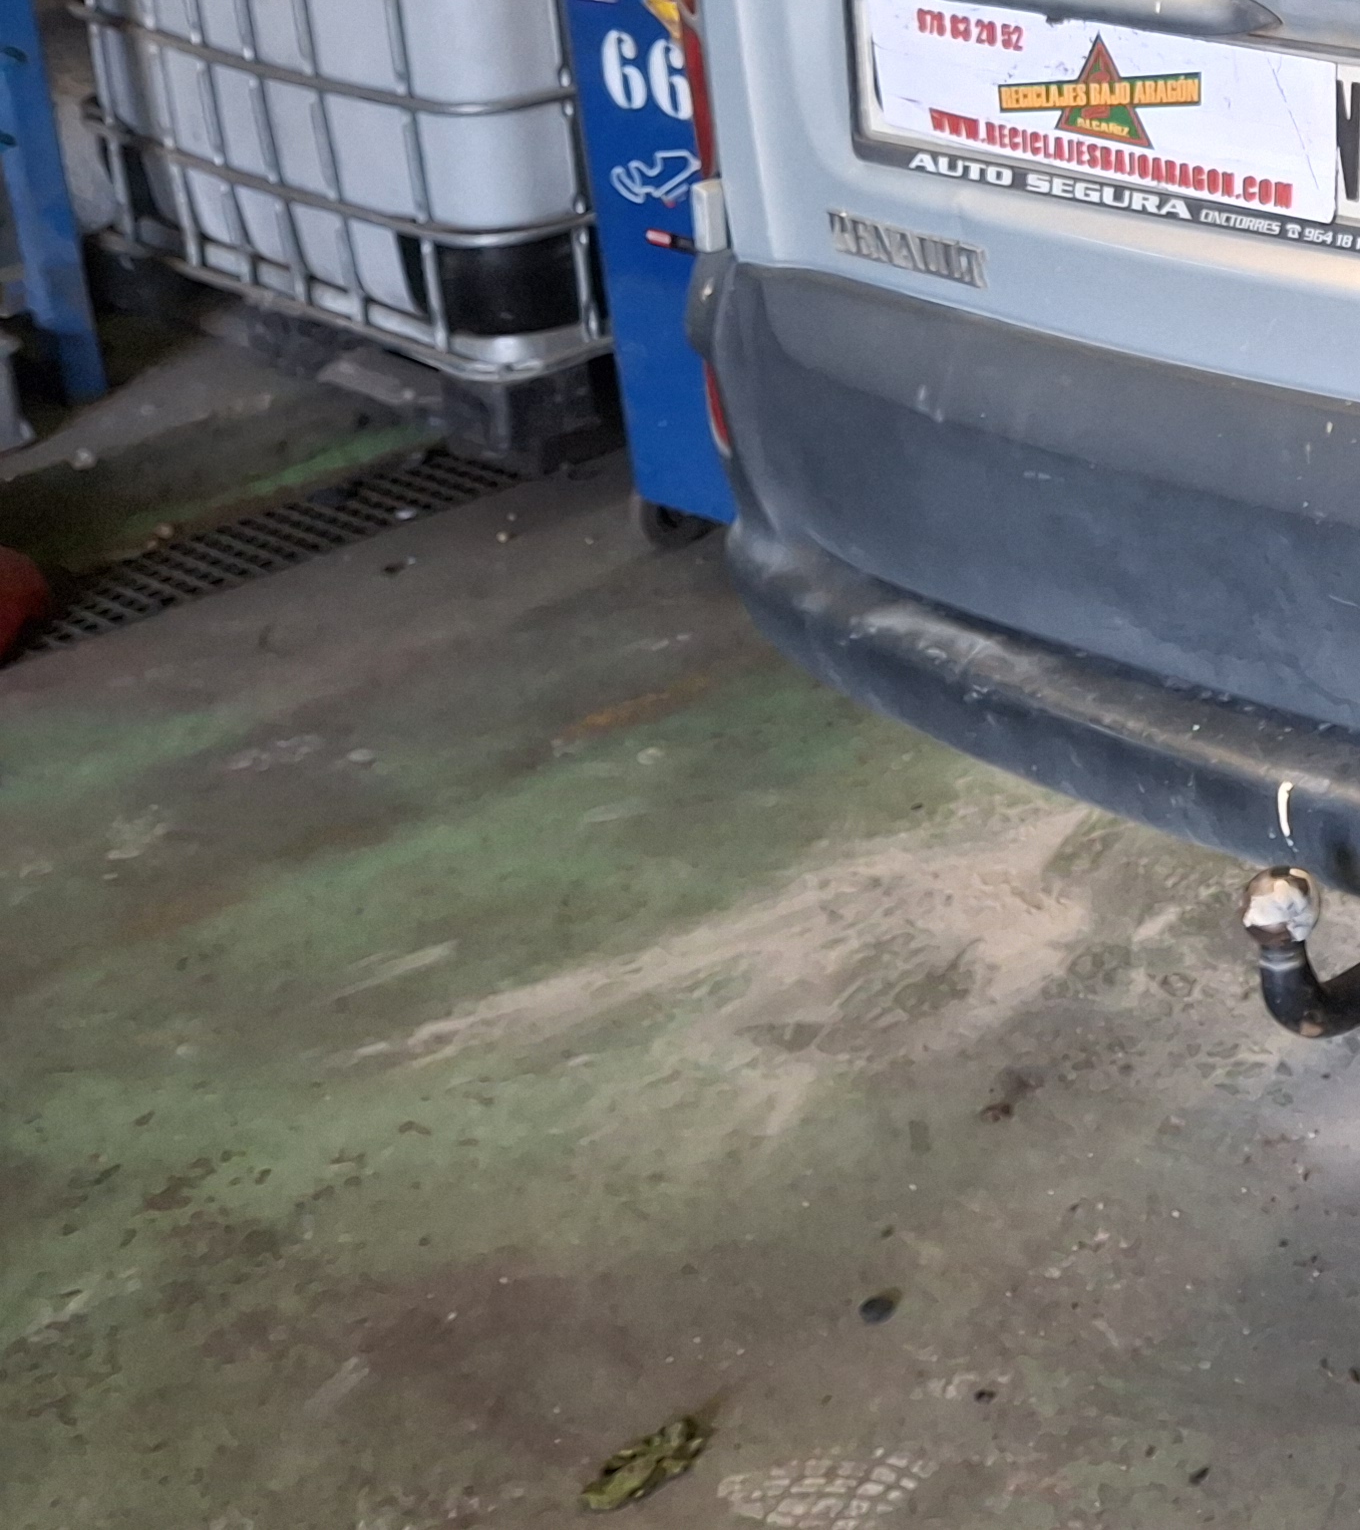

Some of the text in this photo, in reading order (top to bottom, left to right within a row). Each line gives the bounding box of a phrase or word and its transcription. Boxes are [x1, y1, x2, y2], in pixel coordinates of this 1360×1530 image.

[974, 18, 997, 47] 20
[1000, 22, 1024, 52] 52
[602, 29, 694, 120] 66
[1001, 81, 1087, 110] RECICLAJES
[1089, 80, 1131, 107] BAJO
[908, 151, 1013, 187] AUTO
[1025, 172, 1192, 220] SEGURA
[1303, 227, 1333, 246] 964
[1336, 233, 1353, 249] 18
[826, 211, 988, 289] RENAULT
